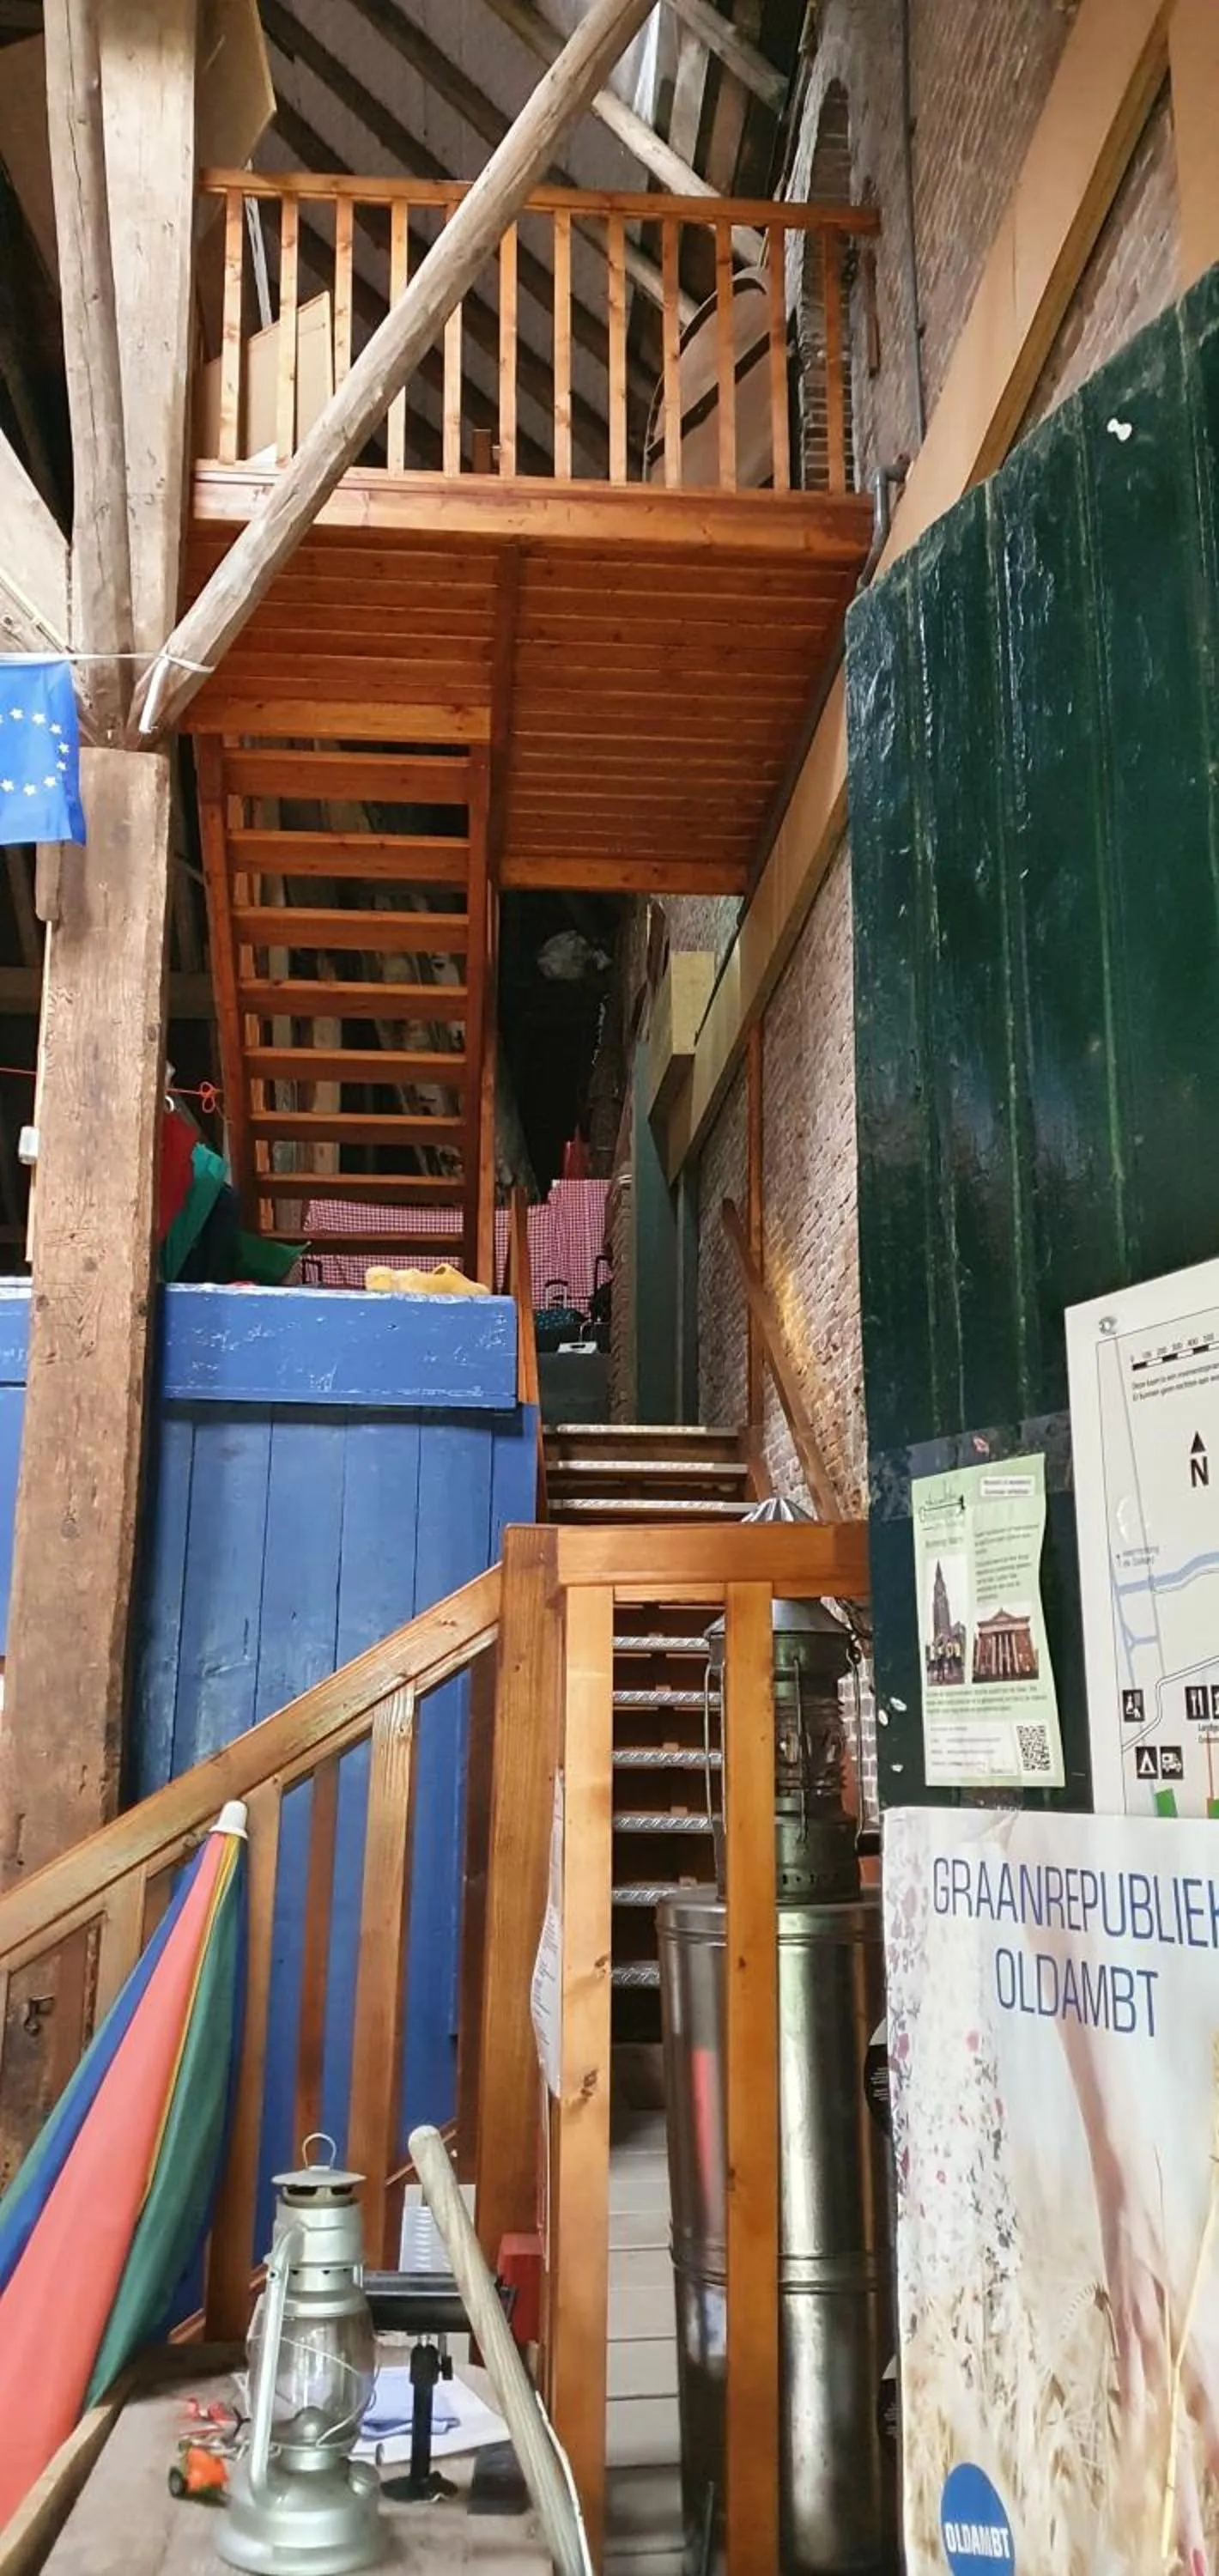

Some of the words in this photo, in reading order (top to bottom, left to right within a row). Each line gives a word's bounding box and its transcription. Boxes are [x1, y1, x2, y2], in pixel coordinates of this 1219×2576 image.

[1190, 1455, 1210, 1488] N
[995, 1947, 1159, 2038] OLDAMBT
[945, 2522, 1010, 2559] OLDAMBT
